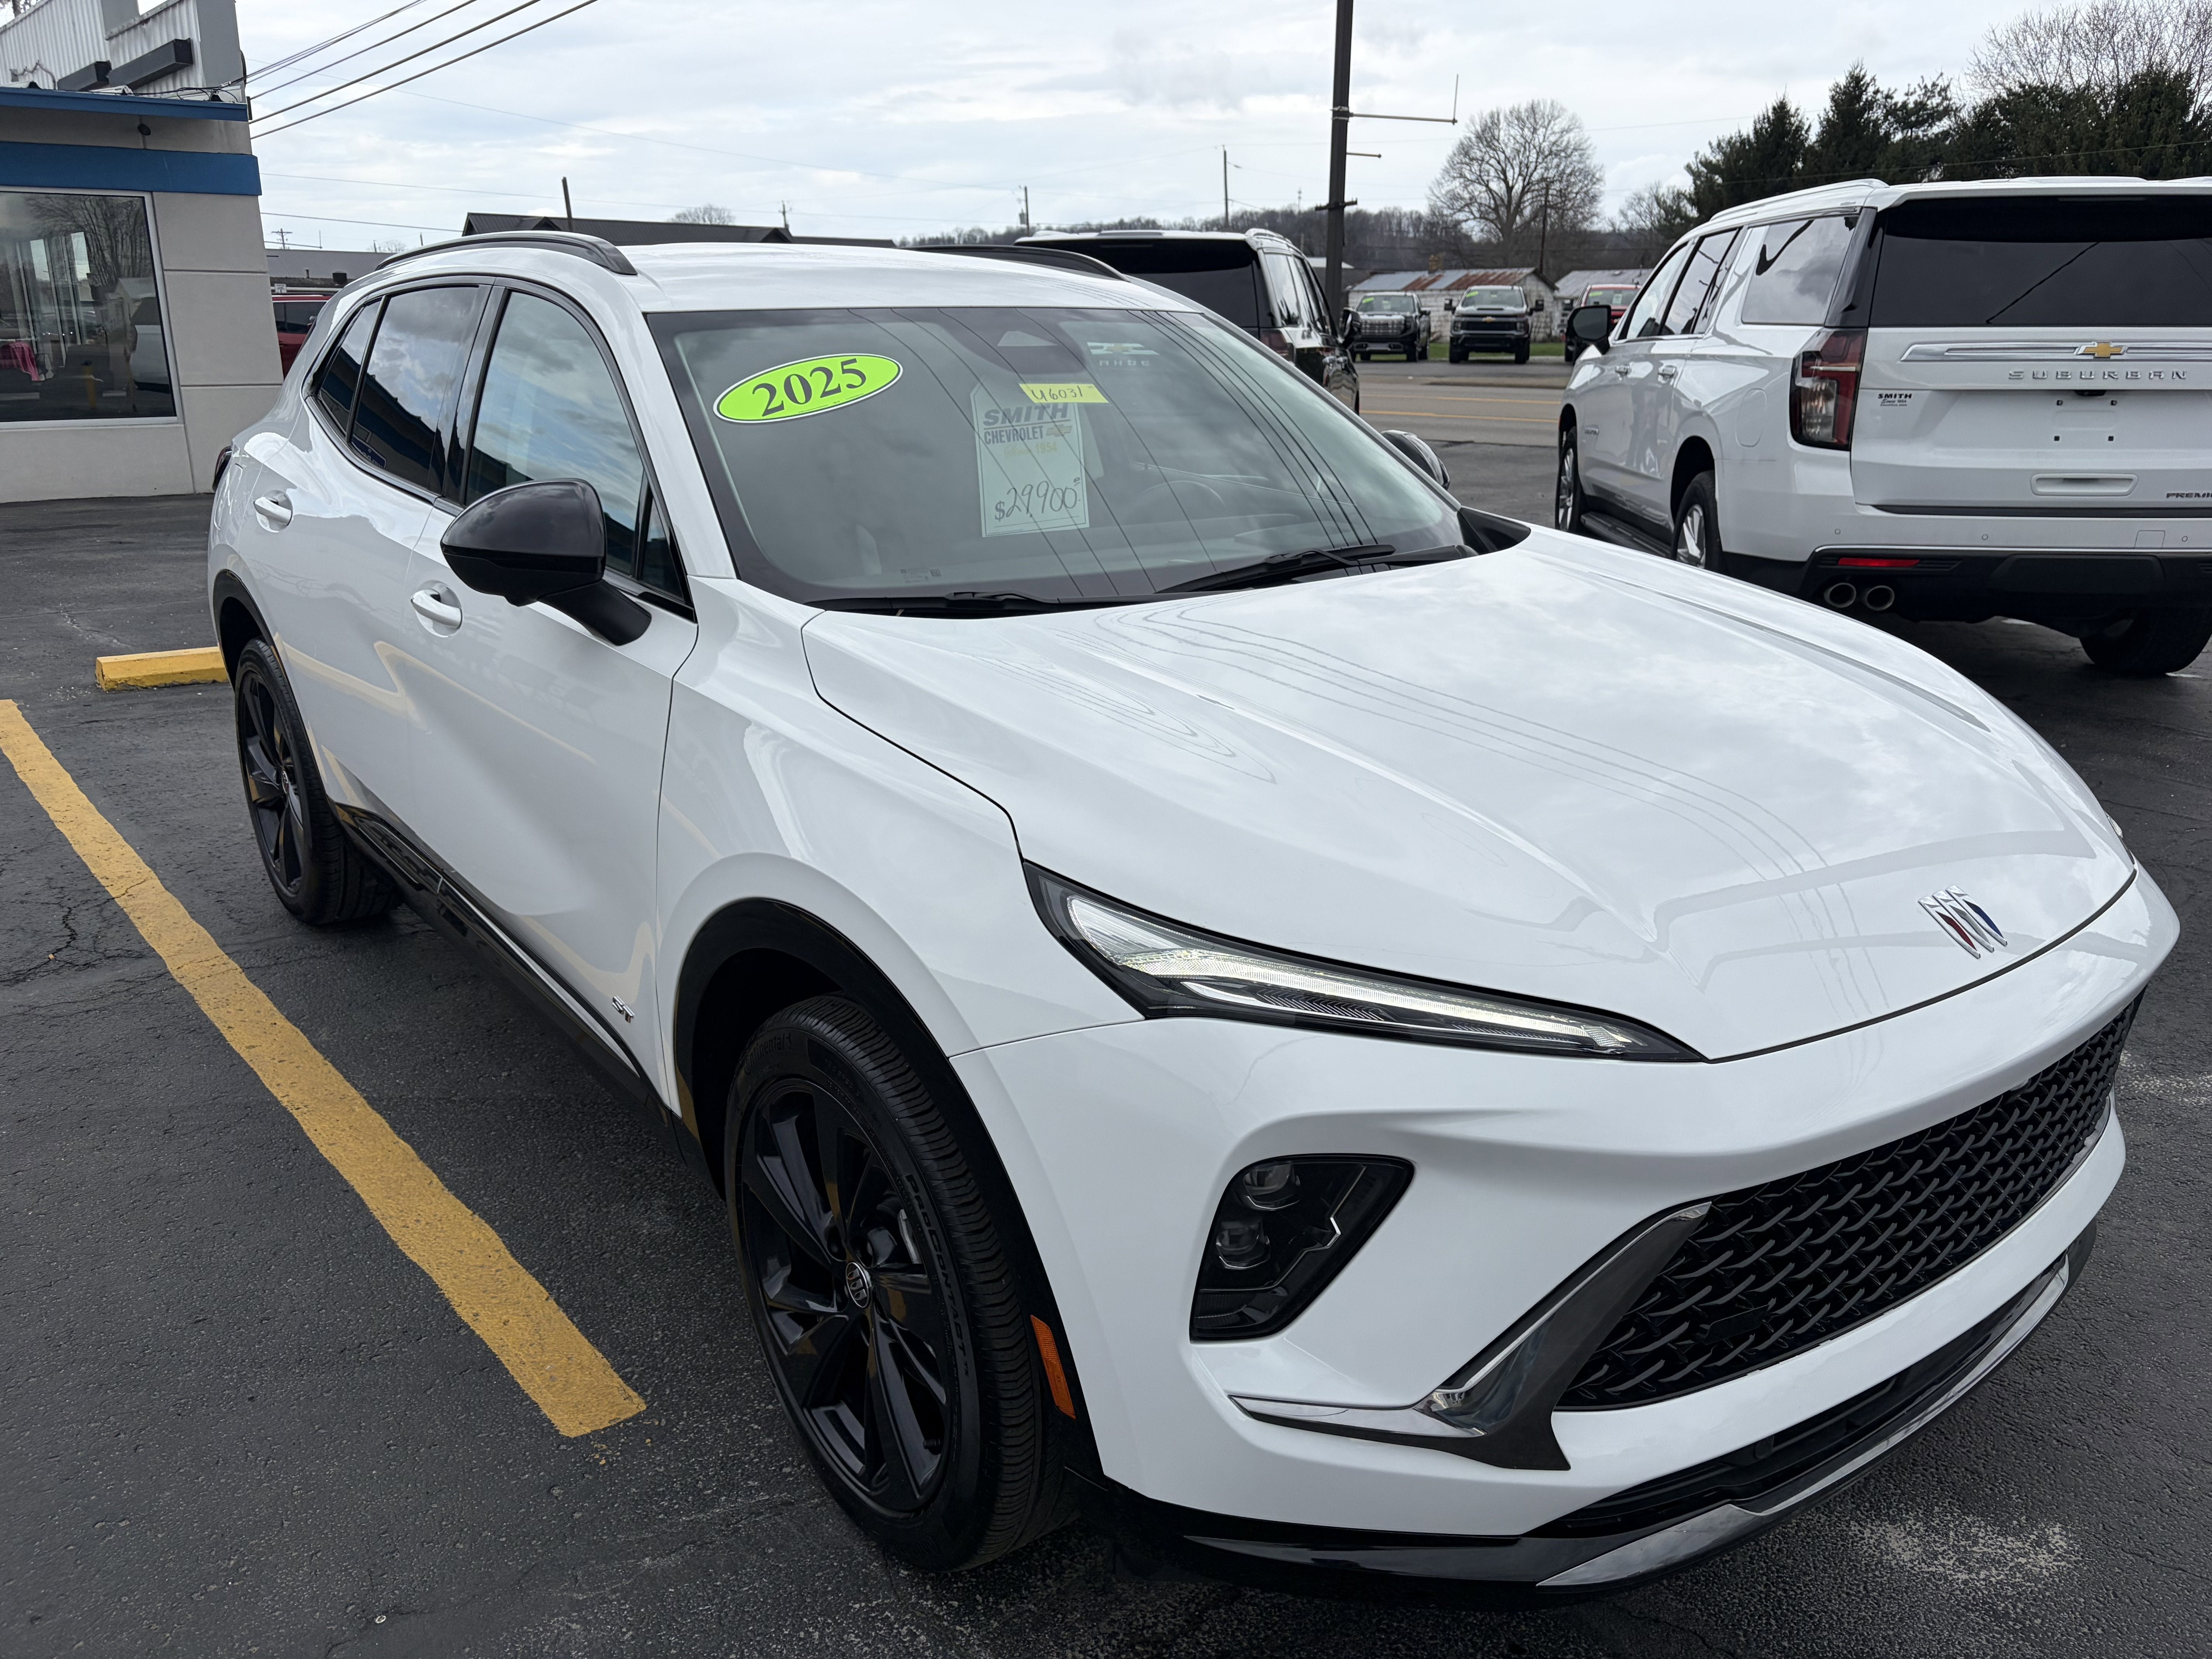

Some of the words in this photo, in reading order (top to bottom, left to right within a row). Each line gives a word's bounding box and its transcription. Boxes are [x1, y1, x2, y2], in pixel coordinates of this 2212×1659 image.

[2008, 370, 2187, 380] SUBURBAN
[752, 358, 866, 417] 2025
[983, 402, 1069, 426] SMITH
[984, 426, 1044, 446] CHEVROLET
[1036, 441, 1058, 454] 1954
[612, 995, 635, 1023] ST
[744, 1033, 785, 1075] Continental
